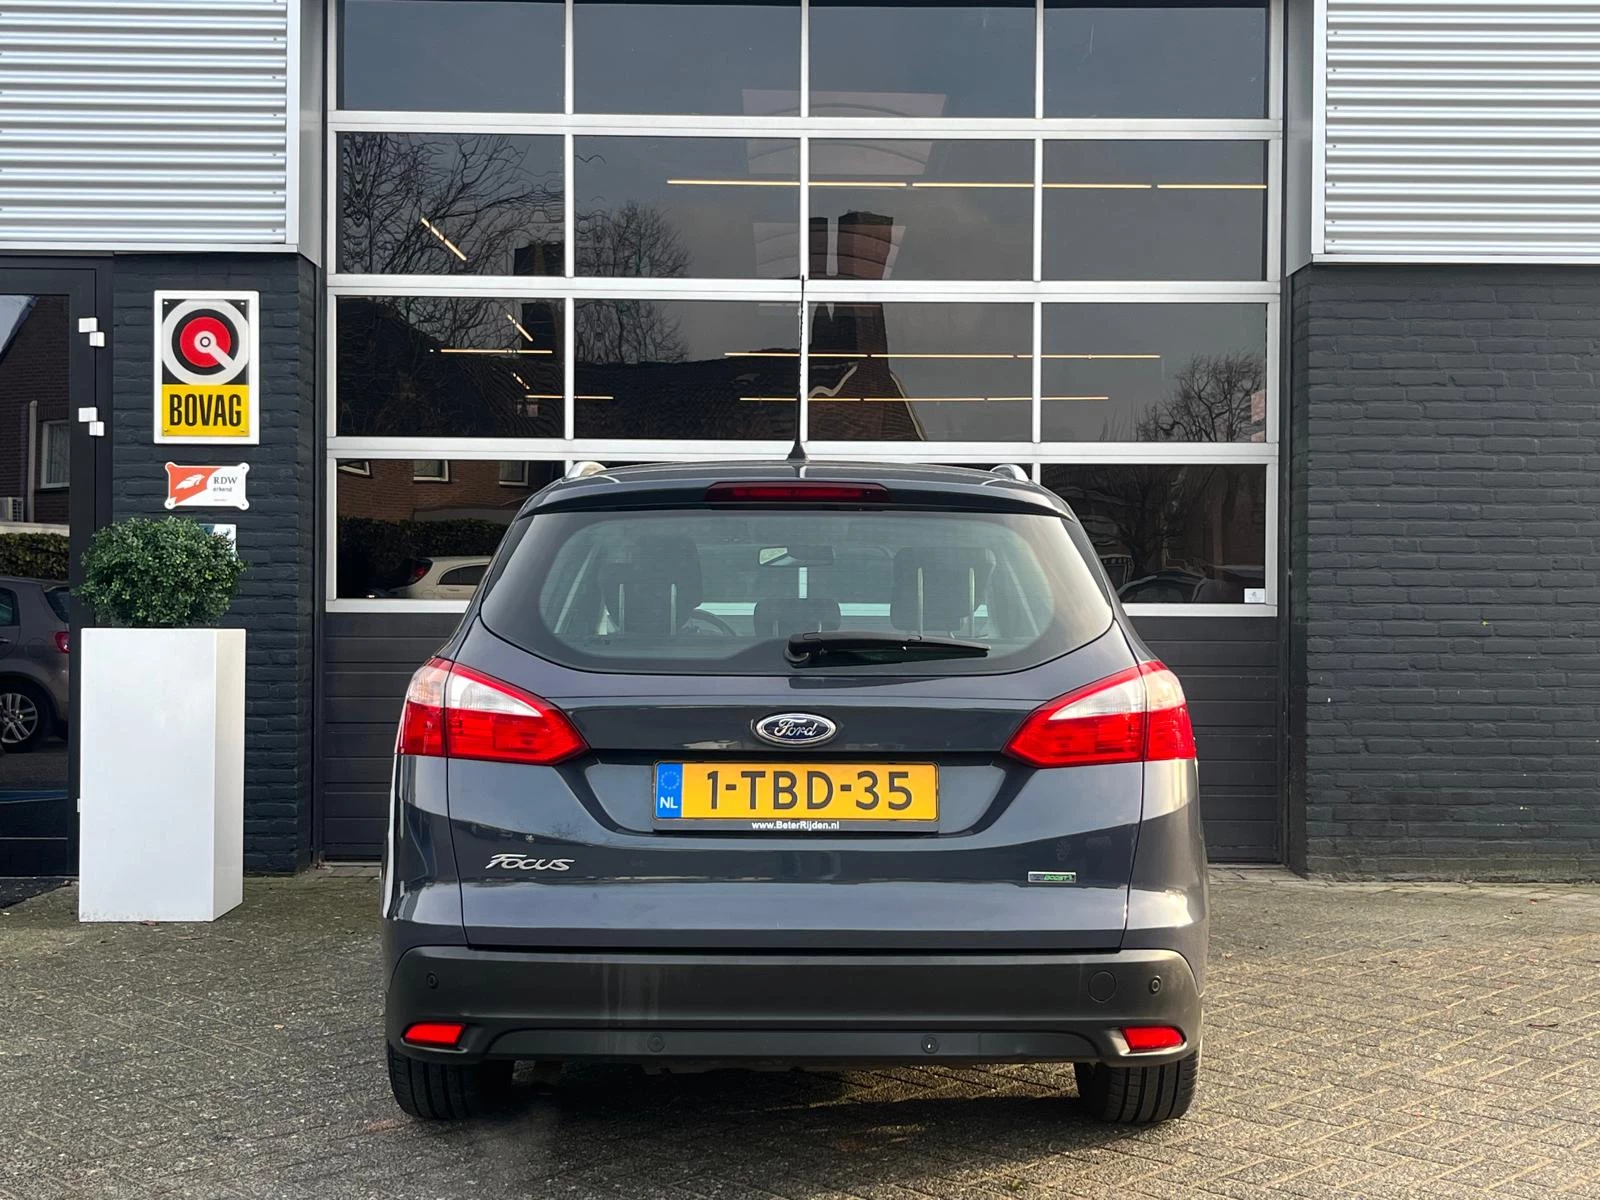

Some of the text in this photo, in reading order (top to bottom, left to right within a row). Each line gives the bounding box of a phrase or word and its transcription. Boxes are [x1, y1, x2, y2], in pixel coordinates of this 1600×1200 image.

[169, 394, 242, 427] BOVAG
[213, 476, 238, 485] RDW
[774, 718, 818, 736] Ford
[706, 770, 913, 811] 1-TBD-35
[659, 796, 679, 809] NL
[751, 820, 840, 831] www.BeterRijden.nl
